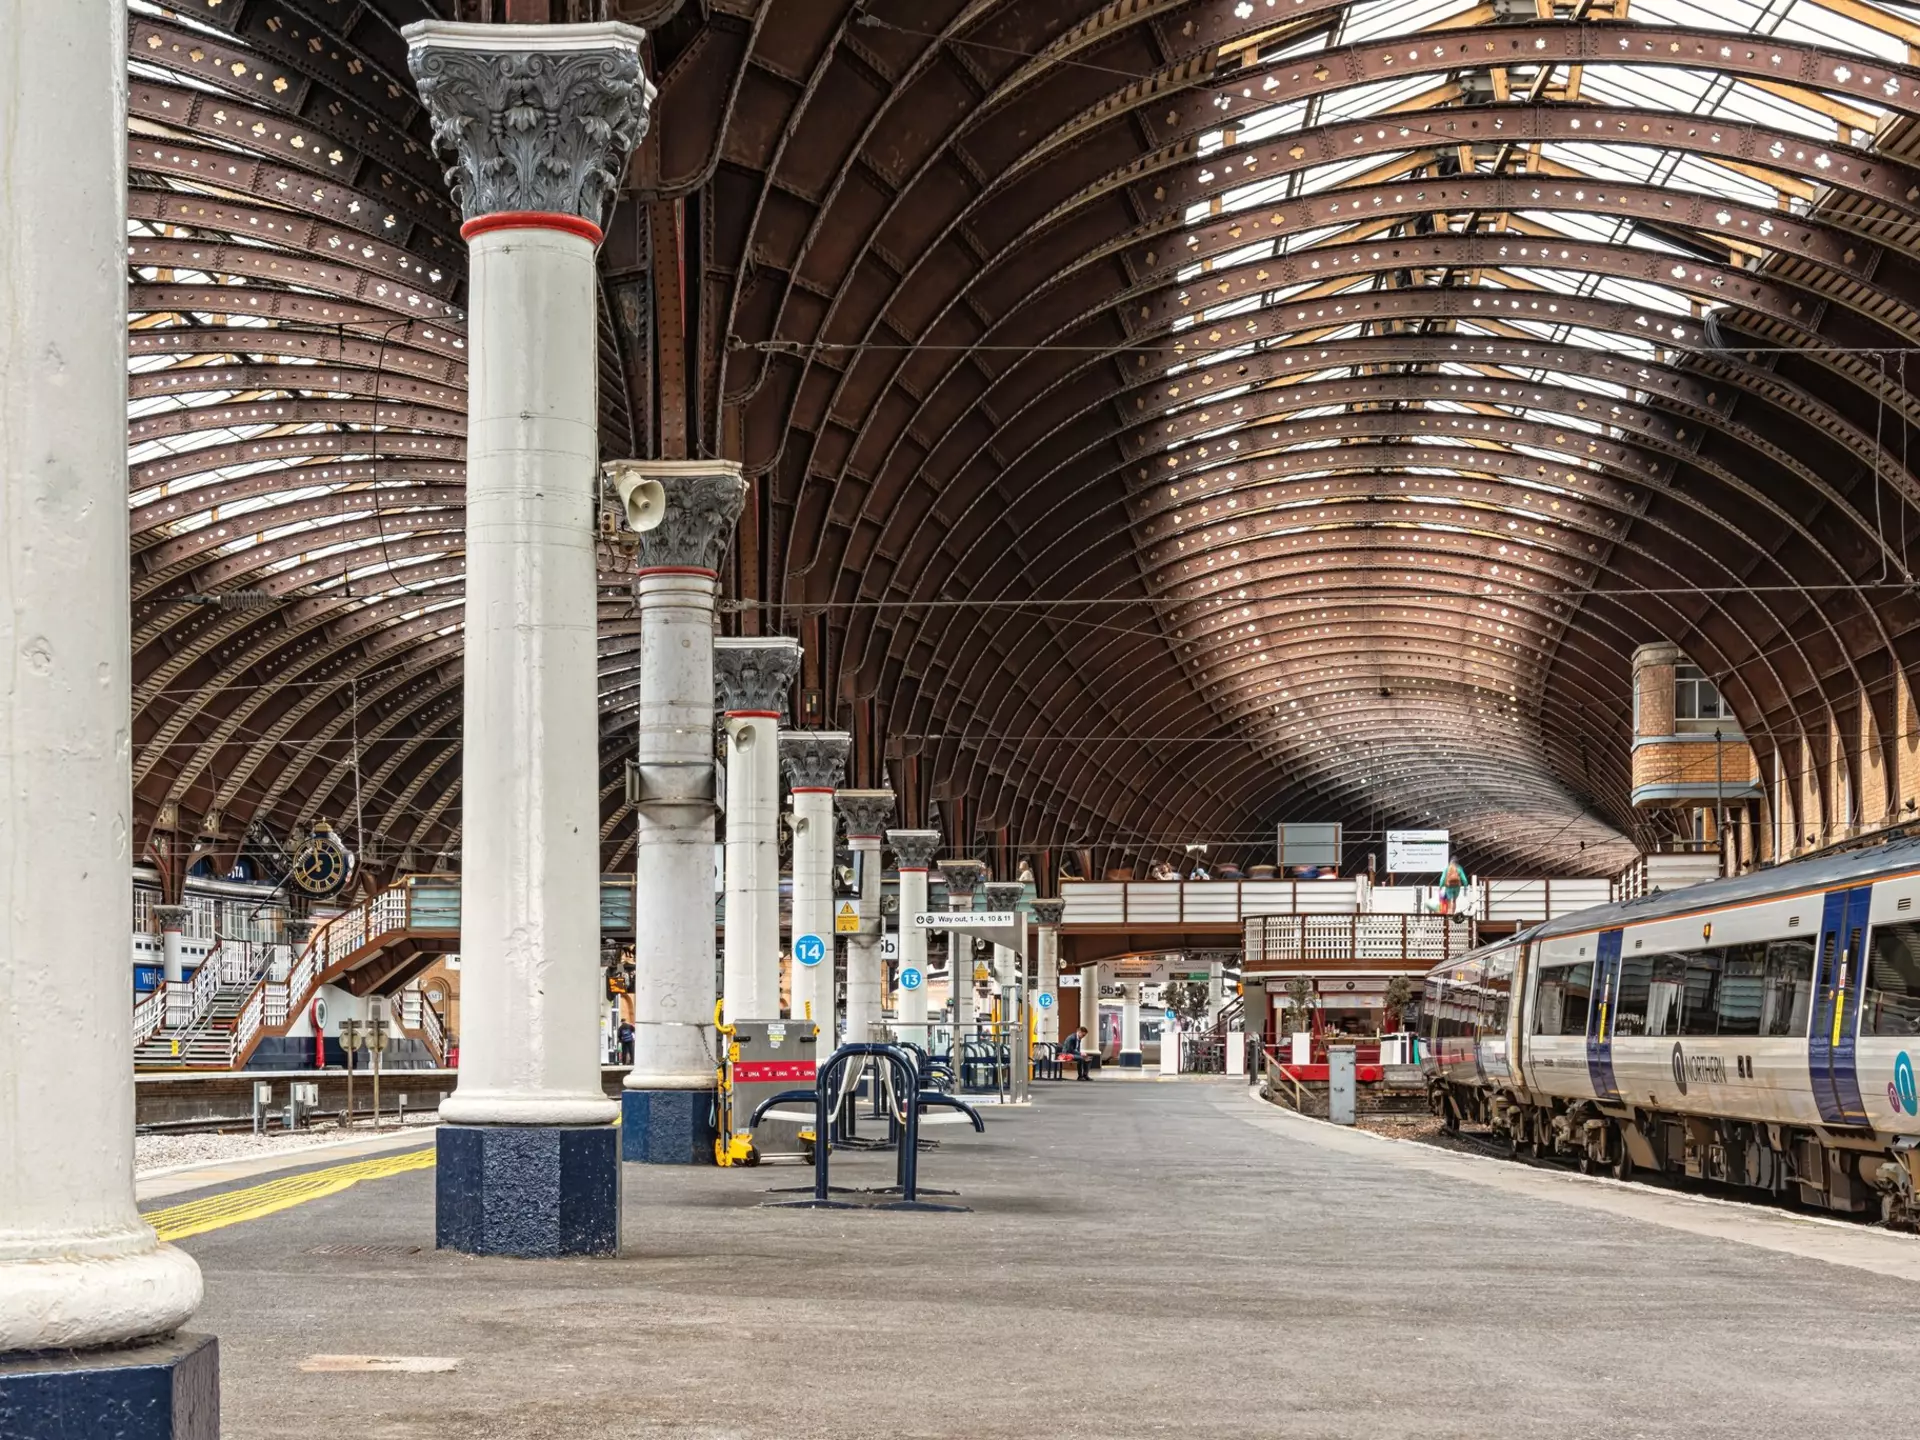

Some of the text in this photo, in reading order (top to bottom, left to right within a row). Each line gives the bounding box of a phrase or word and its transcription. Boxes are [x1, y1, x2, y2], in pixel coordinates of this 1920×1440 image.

[799, 944, 820, 960] 14
[904, 974, 918, 985] 13
[1101, 986, 1114, 995] 5b
[1041, 997, 1051, 1005] 12
[1685, 1055, 1727, 1083] NORTHERN
